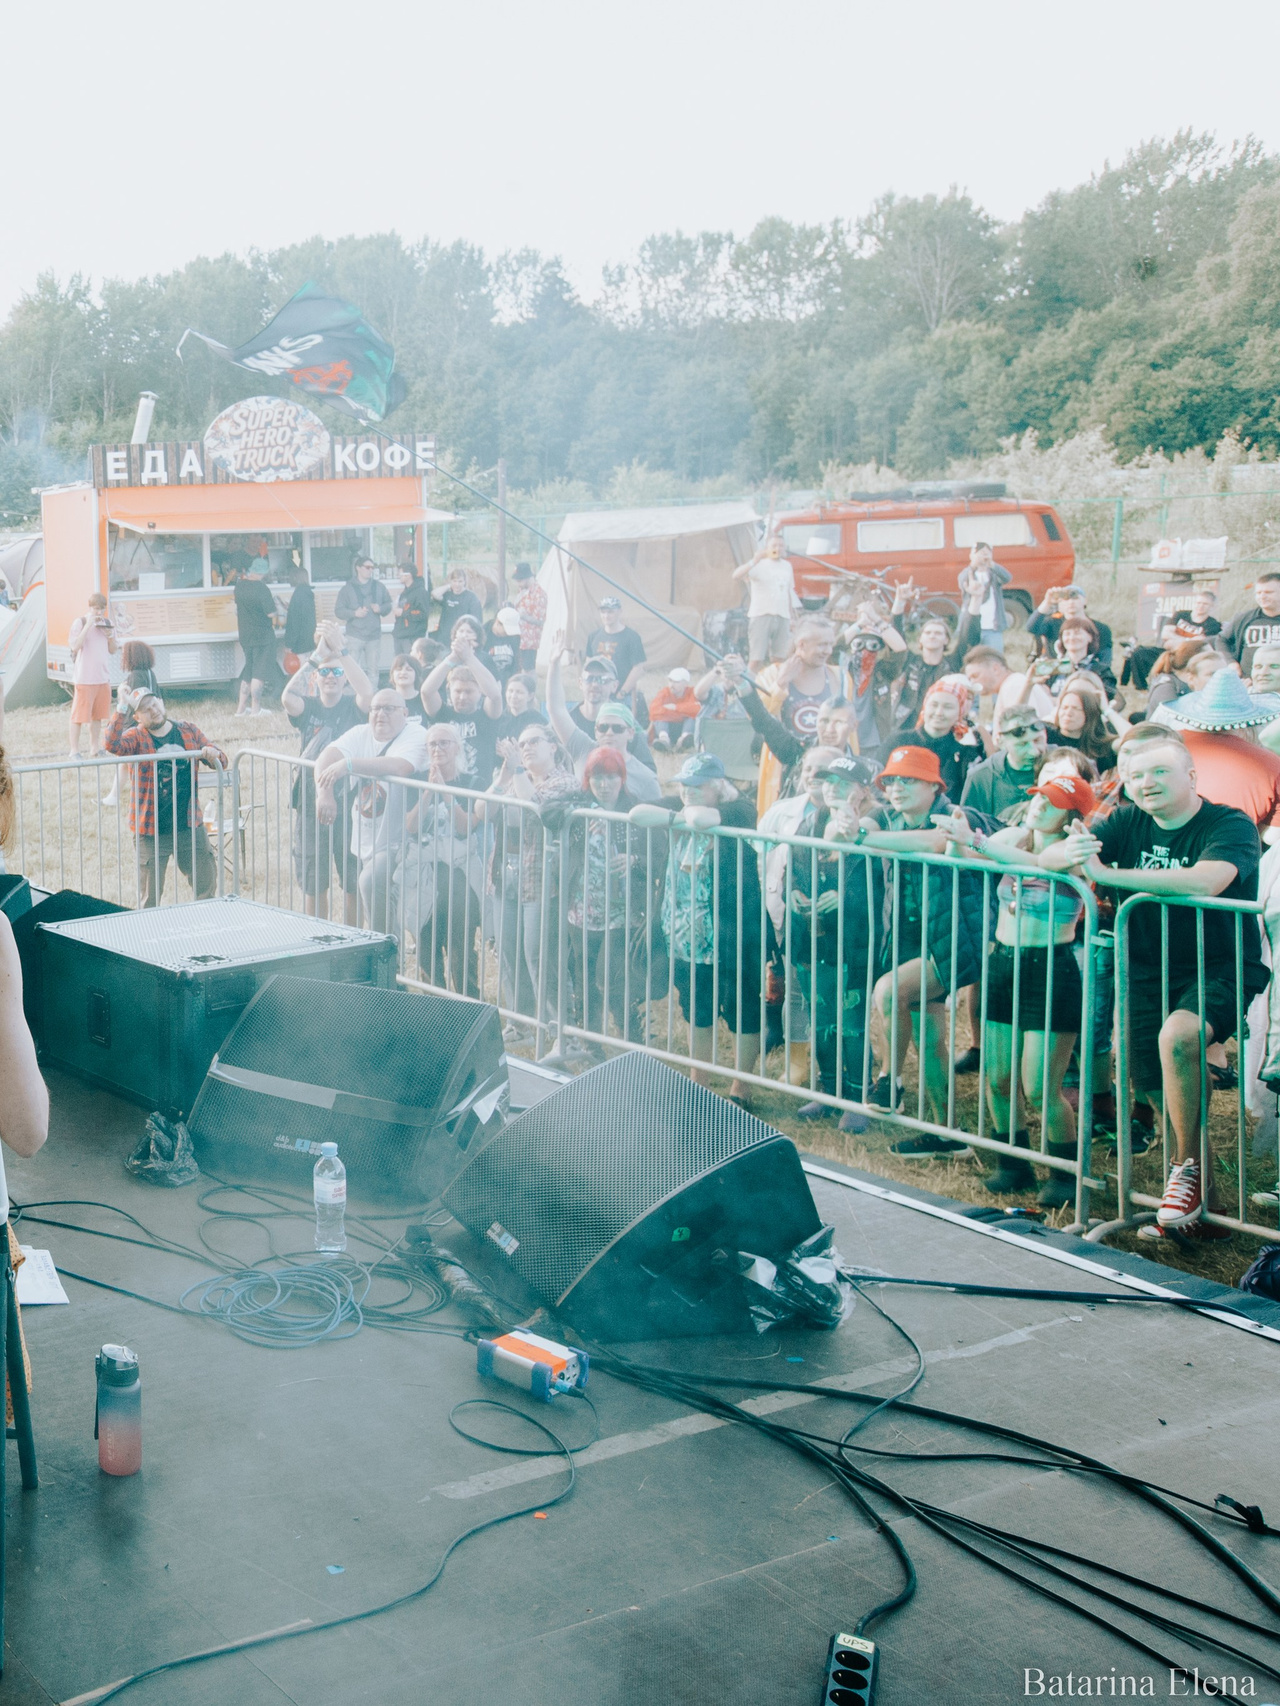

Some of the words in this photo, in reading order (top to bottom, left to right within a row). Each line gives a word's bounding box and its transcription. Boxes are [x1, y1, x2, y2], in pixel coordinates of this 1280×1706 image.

[229, 406, 297, 436] SUPER
[240, 426, 292, 449] HERO
[106, 449, 204, 485] ЕДА
[234, 444, 298, 472] TRUCK
[334, 441, 436, 472] КОФЕ
[1152, 845, 1170, 857] THE
[842, 1637, 869, 1650] UPS
